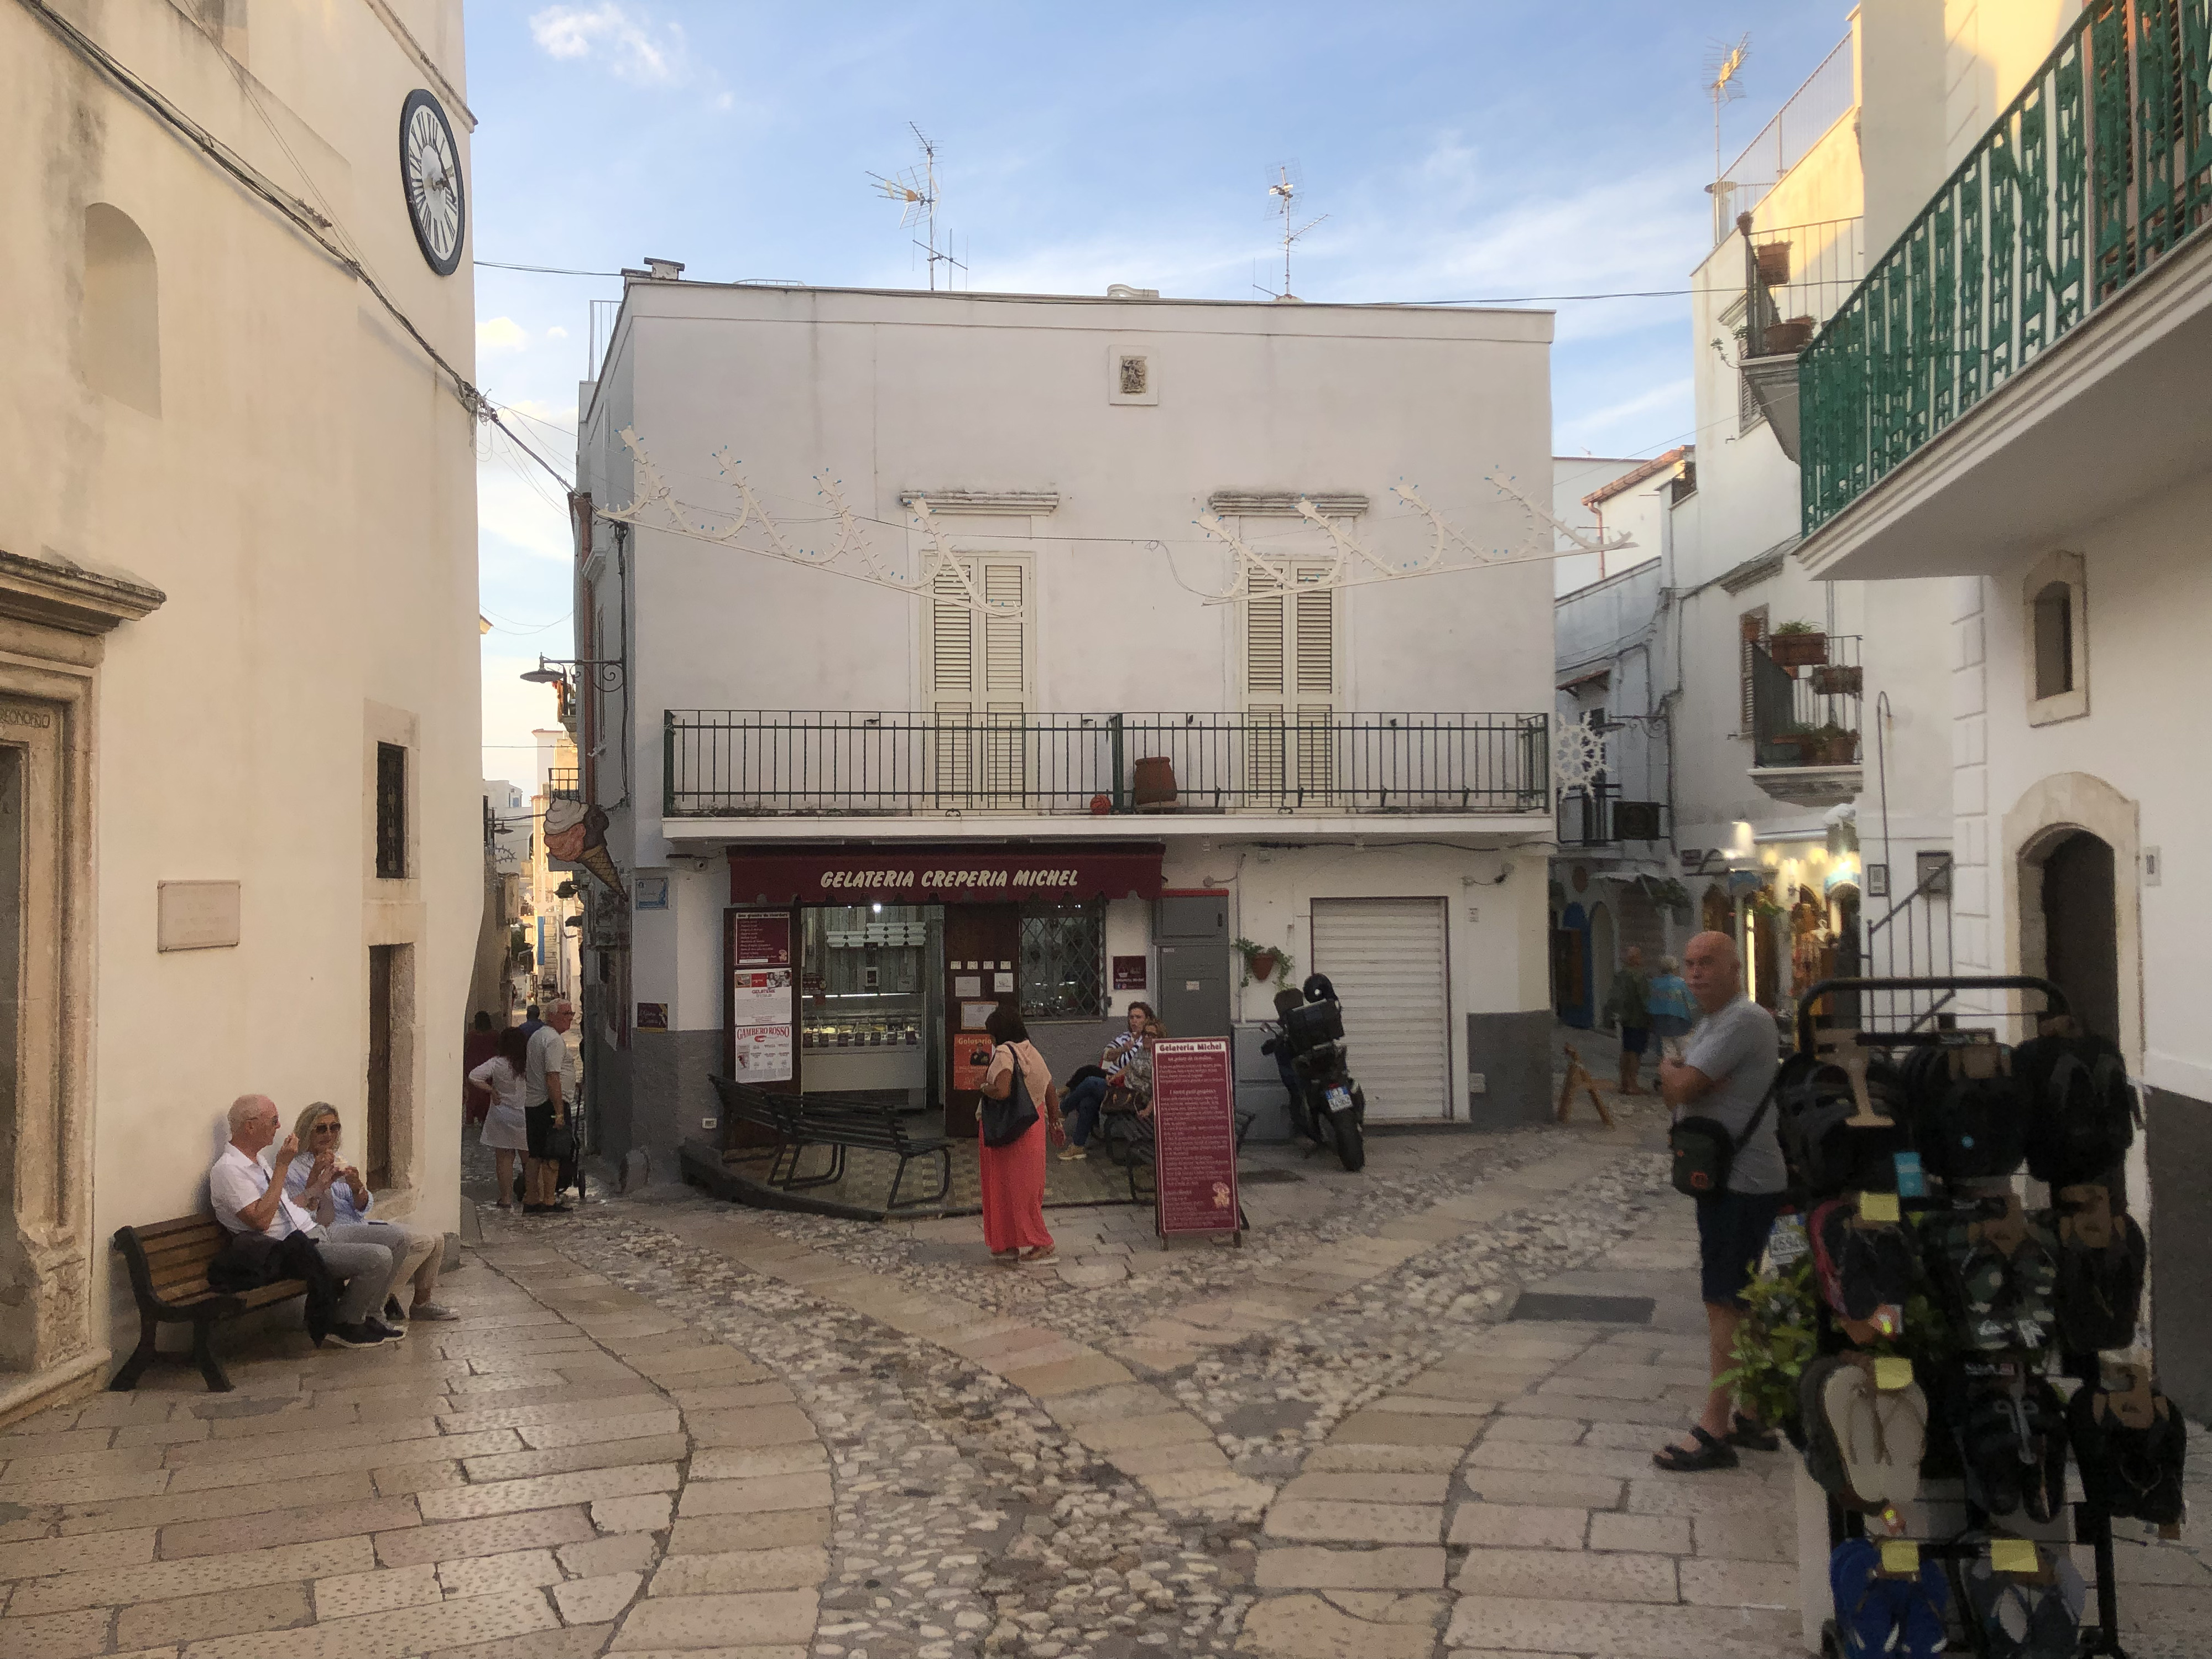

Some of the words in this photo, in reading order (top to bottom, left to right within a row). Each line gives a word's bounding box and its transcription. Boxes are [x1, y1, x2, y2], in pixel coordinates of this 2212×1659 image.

[821, 870, 914, 888] GELATERIA
[921, 870, 1008, 887] CREPERIA
[1012, 869, 1078, 886] MICHEL
[737, 1027, 768, 1040] GAMBERO
[769, 1026, 790, 1038] ROSSO
[1159, 1043, 1194, 1051] Gelateria
[1197, 1042, 1222, 1050] Michel
